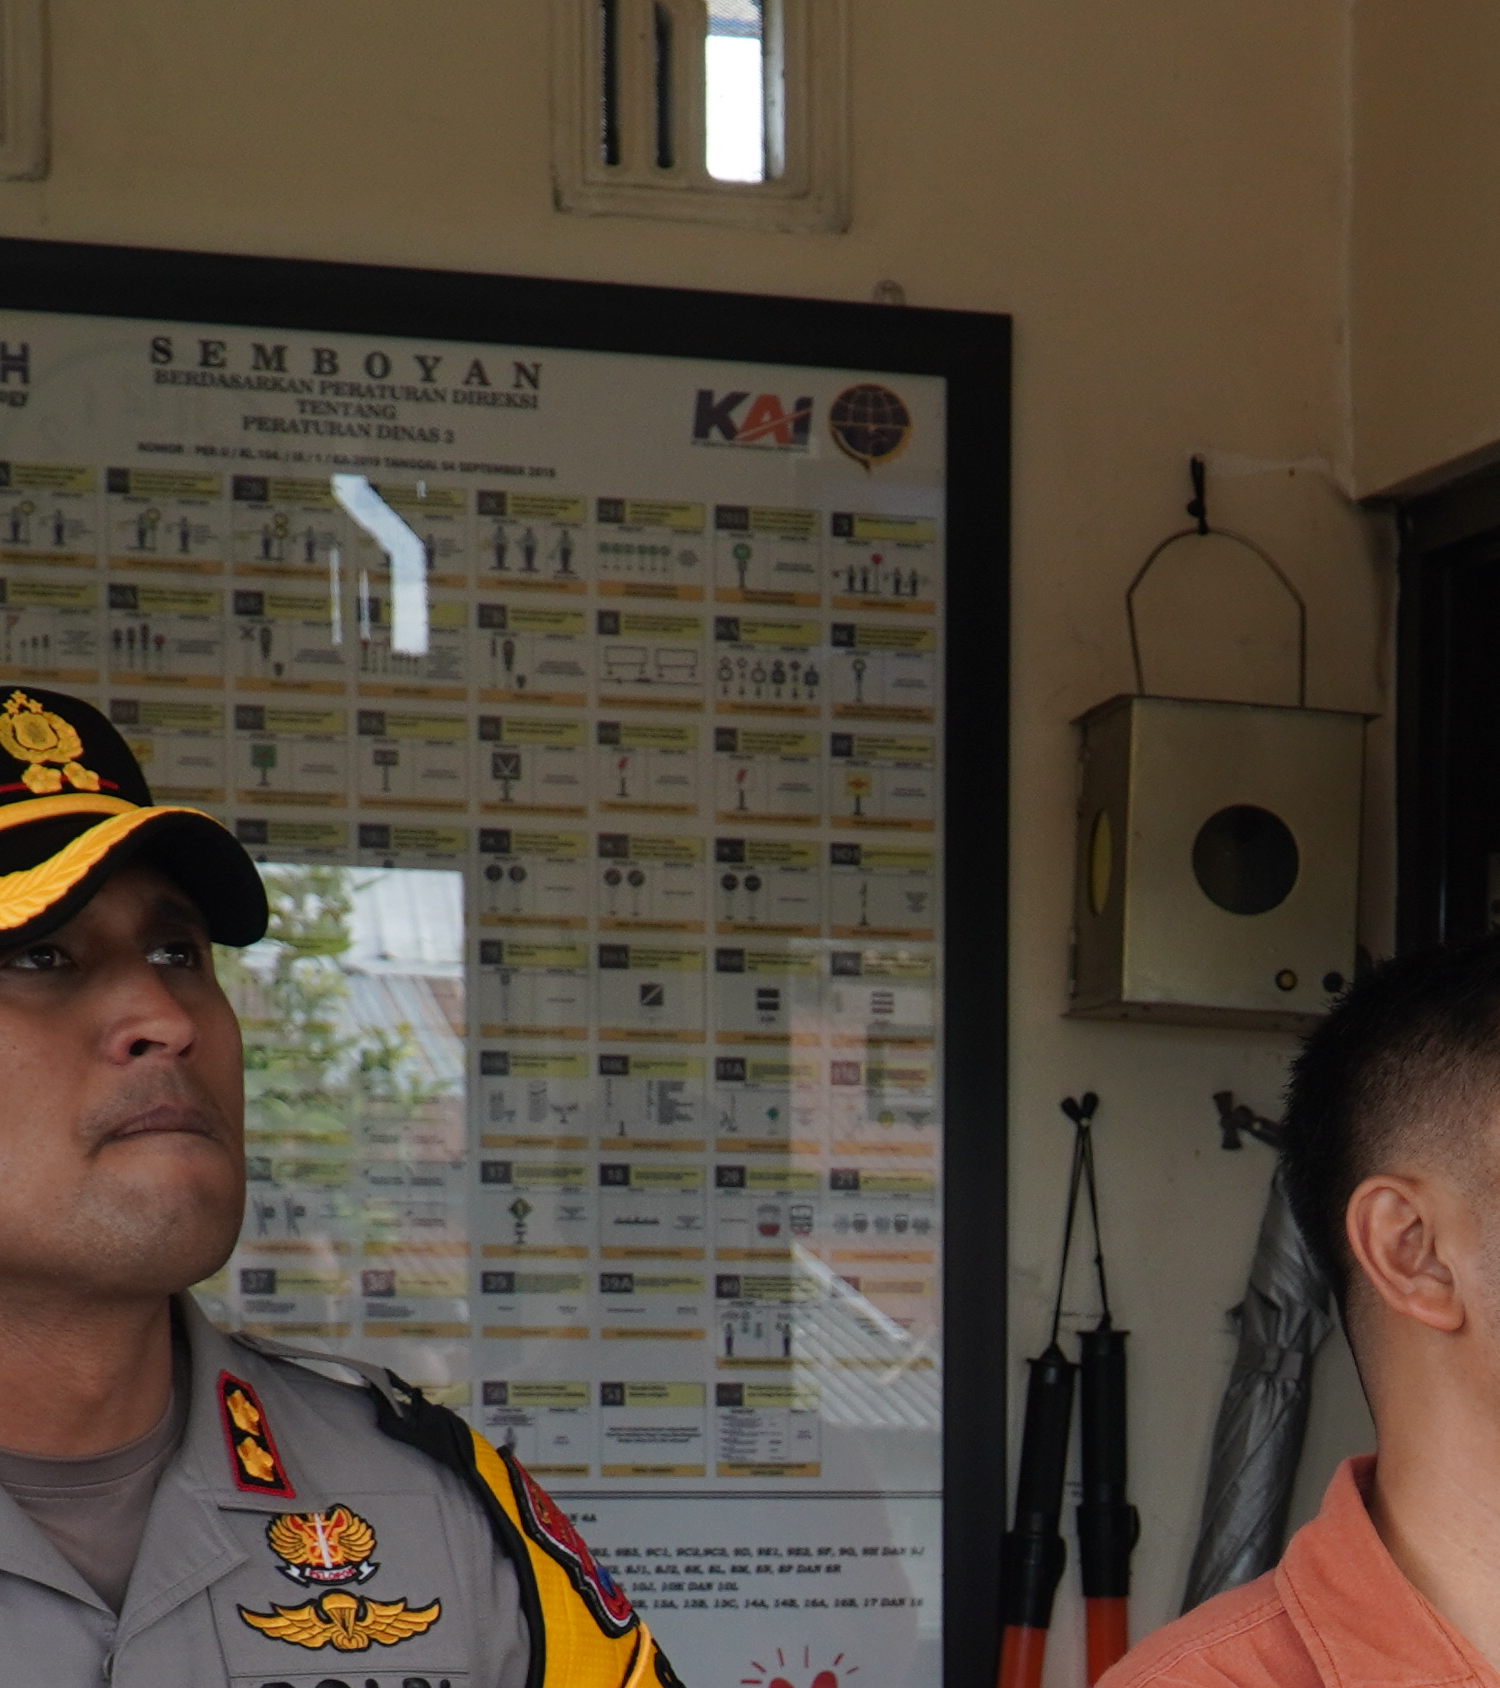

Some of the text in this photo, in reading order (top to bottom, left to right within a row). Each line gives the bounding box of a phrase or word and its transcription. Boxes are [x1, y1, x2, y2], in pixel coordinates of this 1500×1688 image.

[153, 366, 540, 411] BERDASARKAN PERATURAN DIREKSI
[242, 413, 370, 440] PERATURAN
[376, 423, 438, 443] DINAS
[294, 398, 398, 421] TENTANG
[692, 387, 815, 447] KAI
